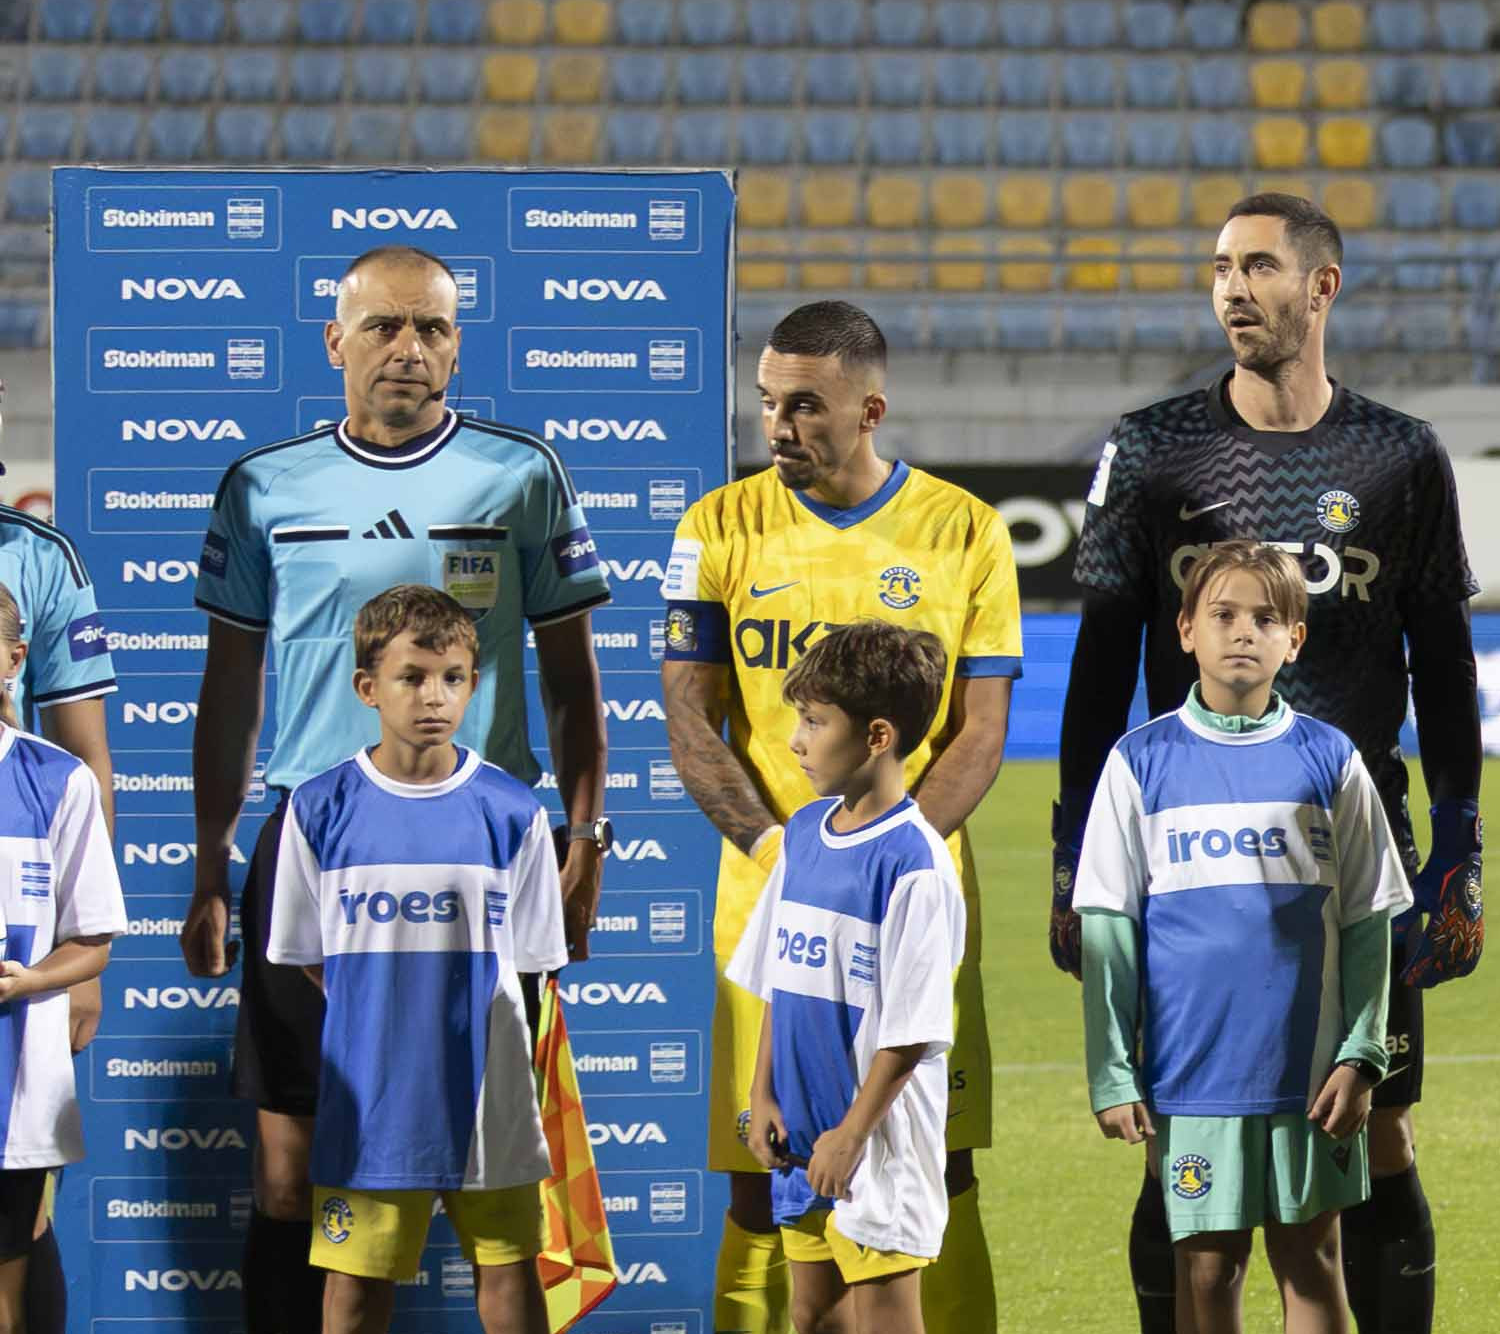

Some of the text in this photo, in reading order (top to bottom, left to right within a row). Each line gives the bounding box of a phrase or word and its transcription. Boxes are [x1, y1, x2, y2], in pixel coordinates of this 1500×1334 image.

[103, 209, 215, 228] Stoiximan
[332, 208, 458, 230] NOVA
[525, 209, 638, 228] Stoiximan
[121, 278, 246, 301] NOVA
[543, 279, 668, 301] NOVA
[103, 349, 215, 368] Stoiximan
[525, 349, 638, 368] Stoiximan
[122, 419, 246, 441] NOVA
[544, 419, 667, 441] NOVA
[447, 554, 495, 575] FIFA
[1167, 827, 1288, 864] iroes
[339, 888, 459, 924] iroes
[106, 1058, 217, 1077] Stoiximan
[125, 1128, 247, 1150] NOVA
[587, 1123, 667, 1145] OVA
